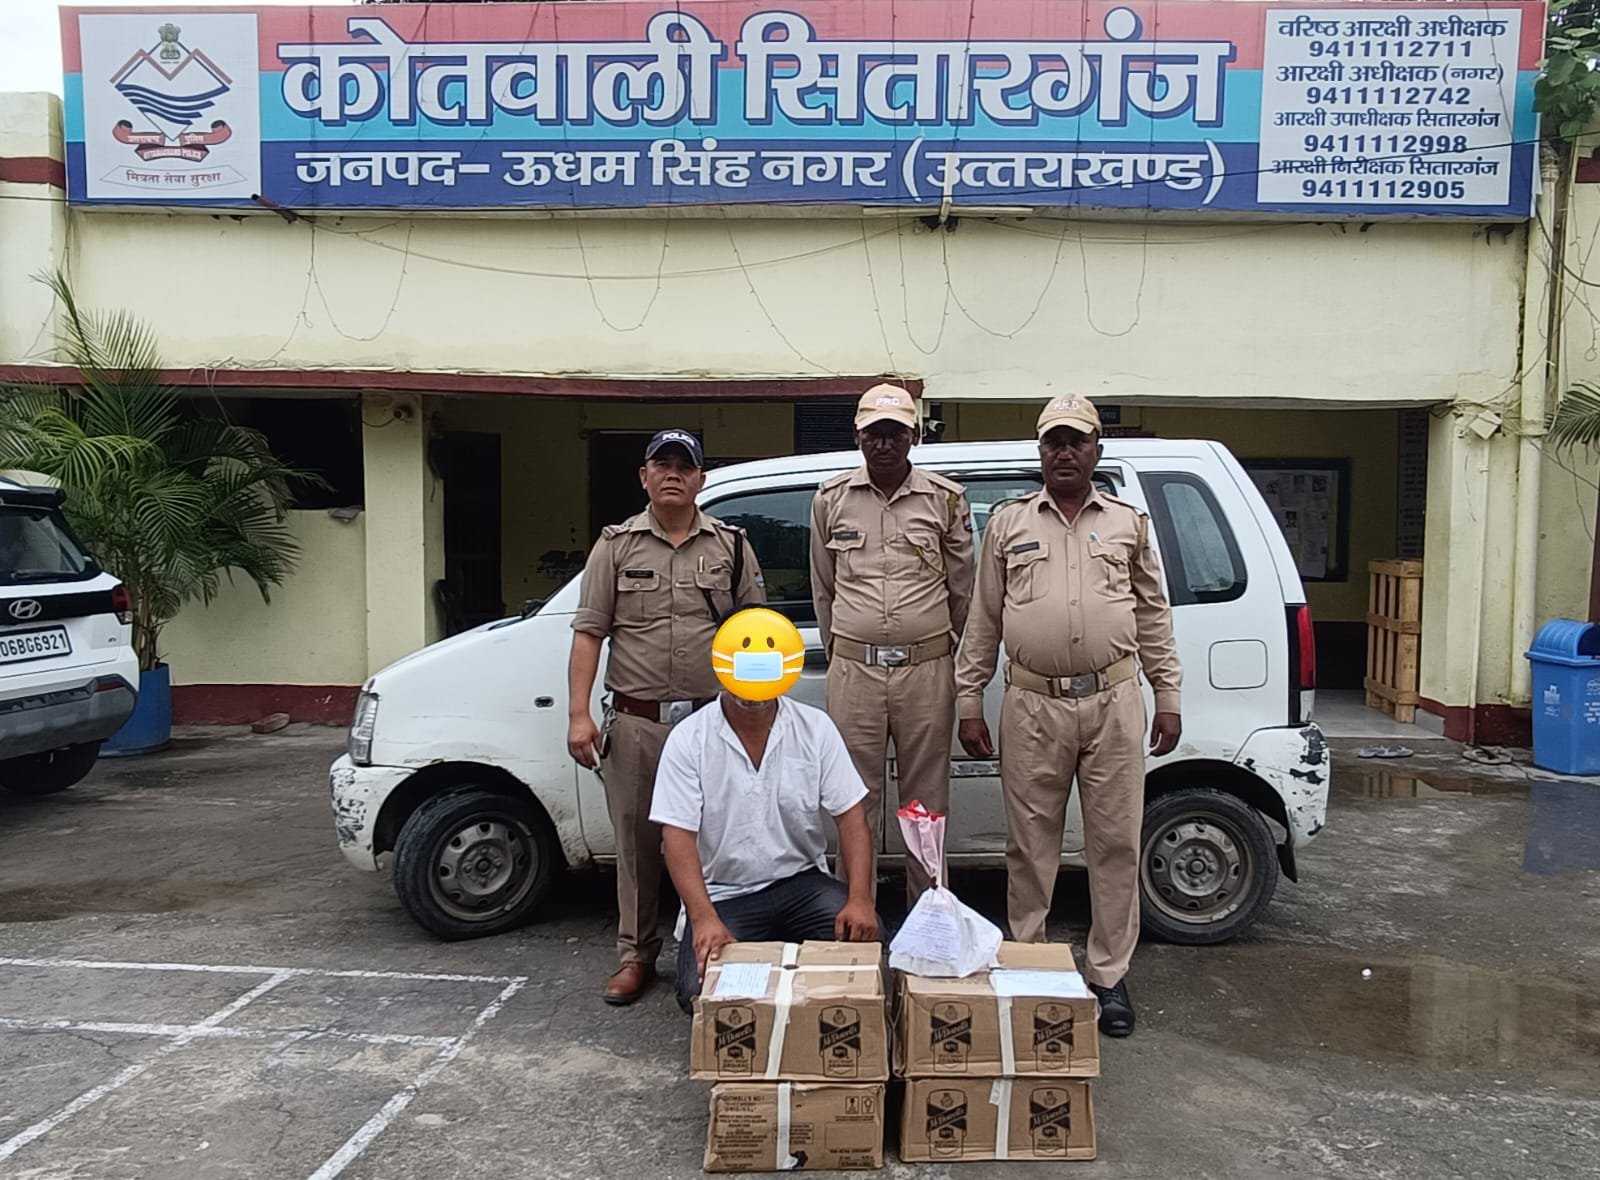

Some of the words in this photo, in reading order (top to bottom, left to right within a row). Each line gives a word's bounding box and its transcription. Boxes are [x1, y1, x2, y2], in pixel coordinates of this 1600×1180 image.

[1278, 15, 1340, 37] वरिष्ठ
[1342, 15, 1413, 37] आरक्षी
[1415, 15, 1508, 38] अधीक्षक
[1308, 40, 1472, 58] 9411112711
[277, 11, 728, 127] कोतवाली
[736, 7, 1236, 127] सितारगंज
[1275, 60, 1344, 82] आरक्षी
[1348, 60, 1440, 82] अधीक्षक
[1441, 63, 1504, 84] (नगर)
[1306, 86, 1471, 105] 9411112742
[1273, 108, 1326, 127] आरक्षी
[1330, 108, 1412, 128] उपाधीक्षक
[1416, 108, 1501, 128] सितारगंज
[1303, 134, 1468, 154] 9411112998
[502, 151, 640, 187] ऊधम
[648, 138, 755, 188] सिंह
[761, 150, 892, 188] नगर
[902, 137, 1225, 204] (उत्तराखण्ड)
[1271, 156, 1326, 175] आरक्षी
[1330, 156, 1405, 175] निरीक्षक
[1410, 156, 1500, 176] सितारगंज
[1302, 179, 1465, 199] 9411112905
[0, 633, 67, 657] 06BG6921
